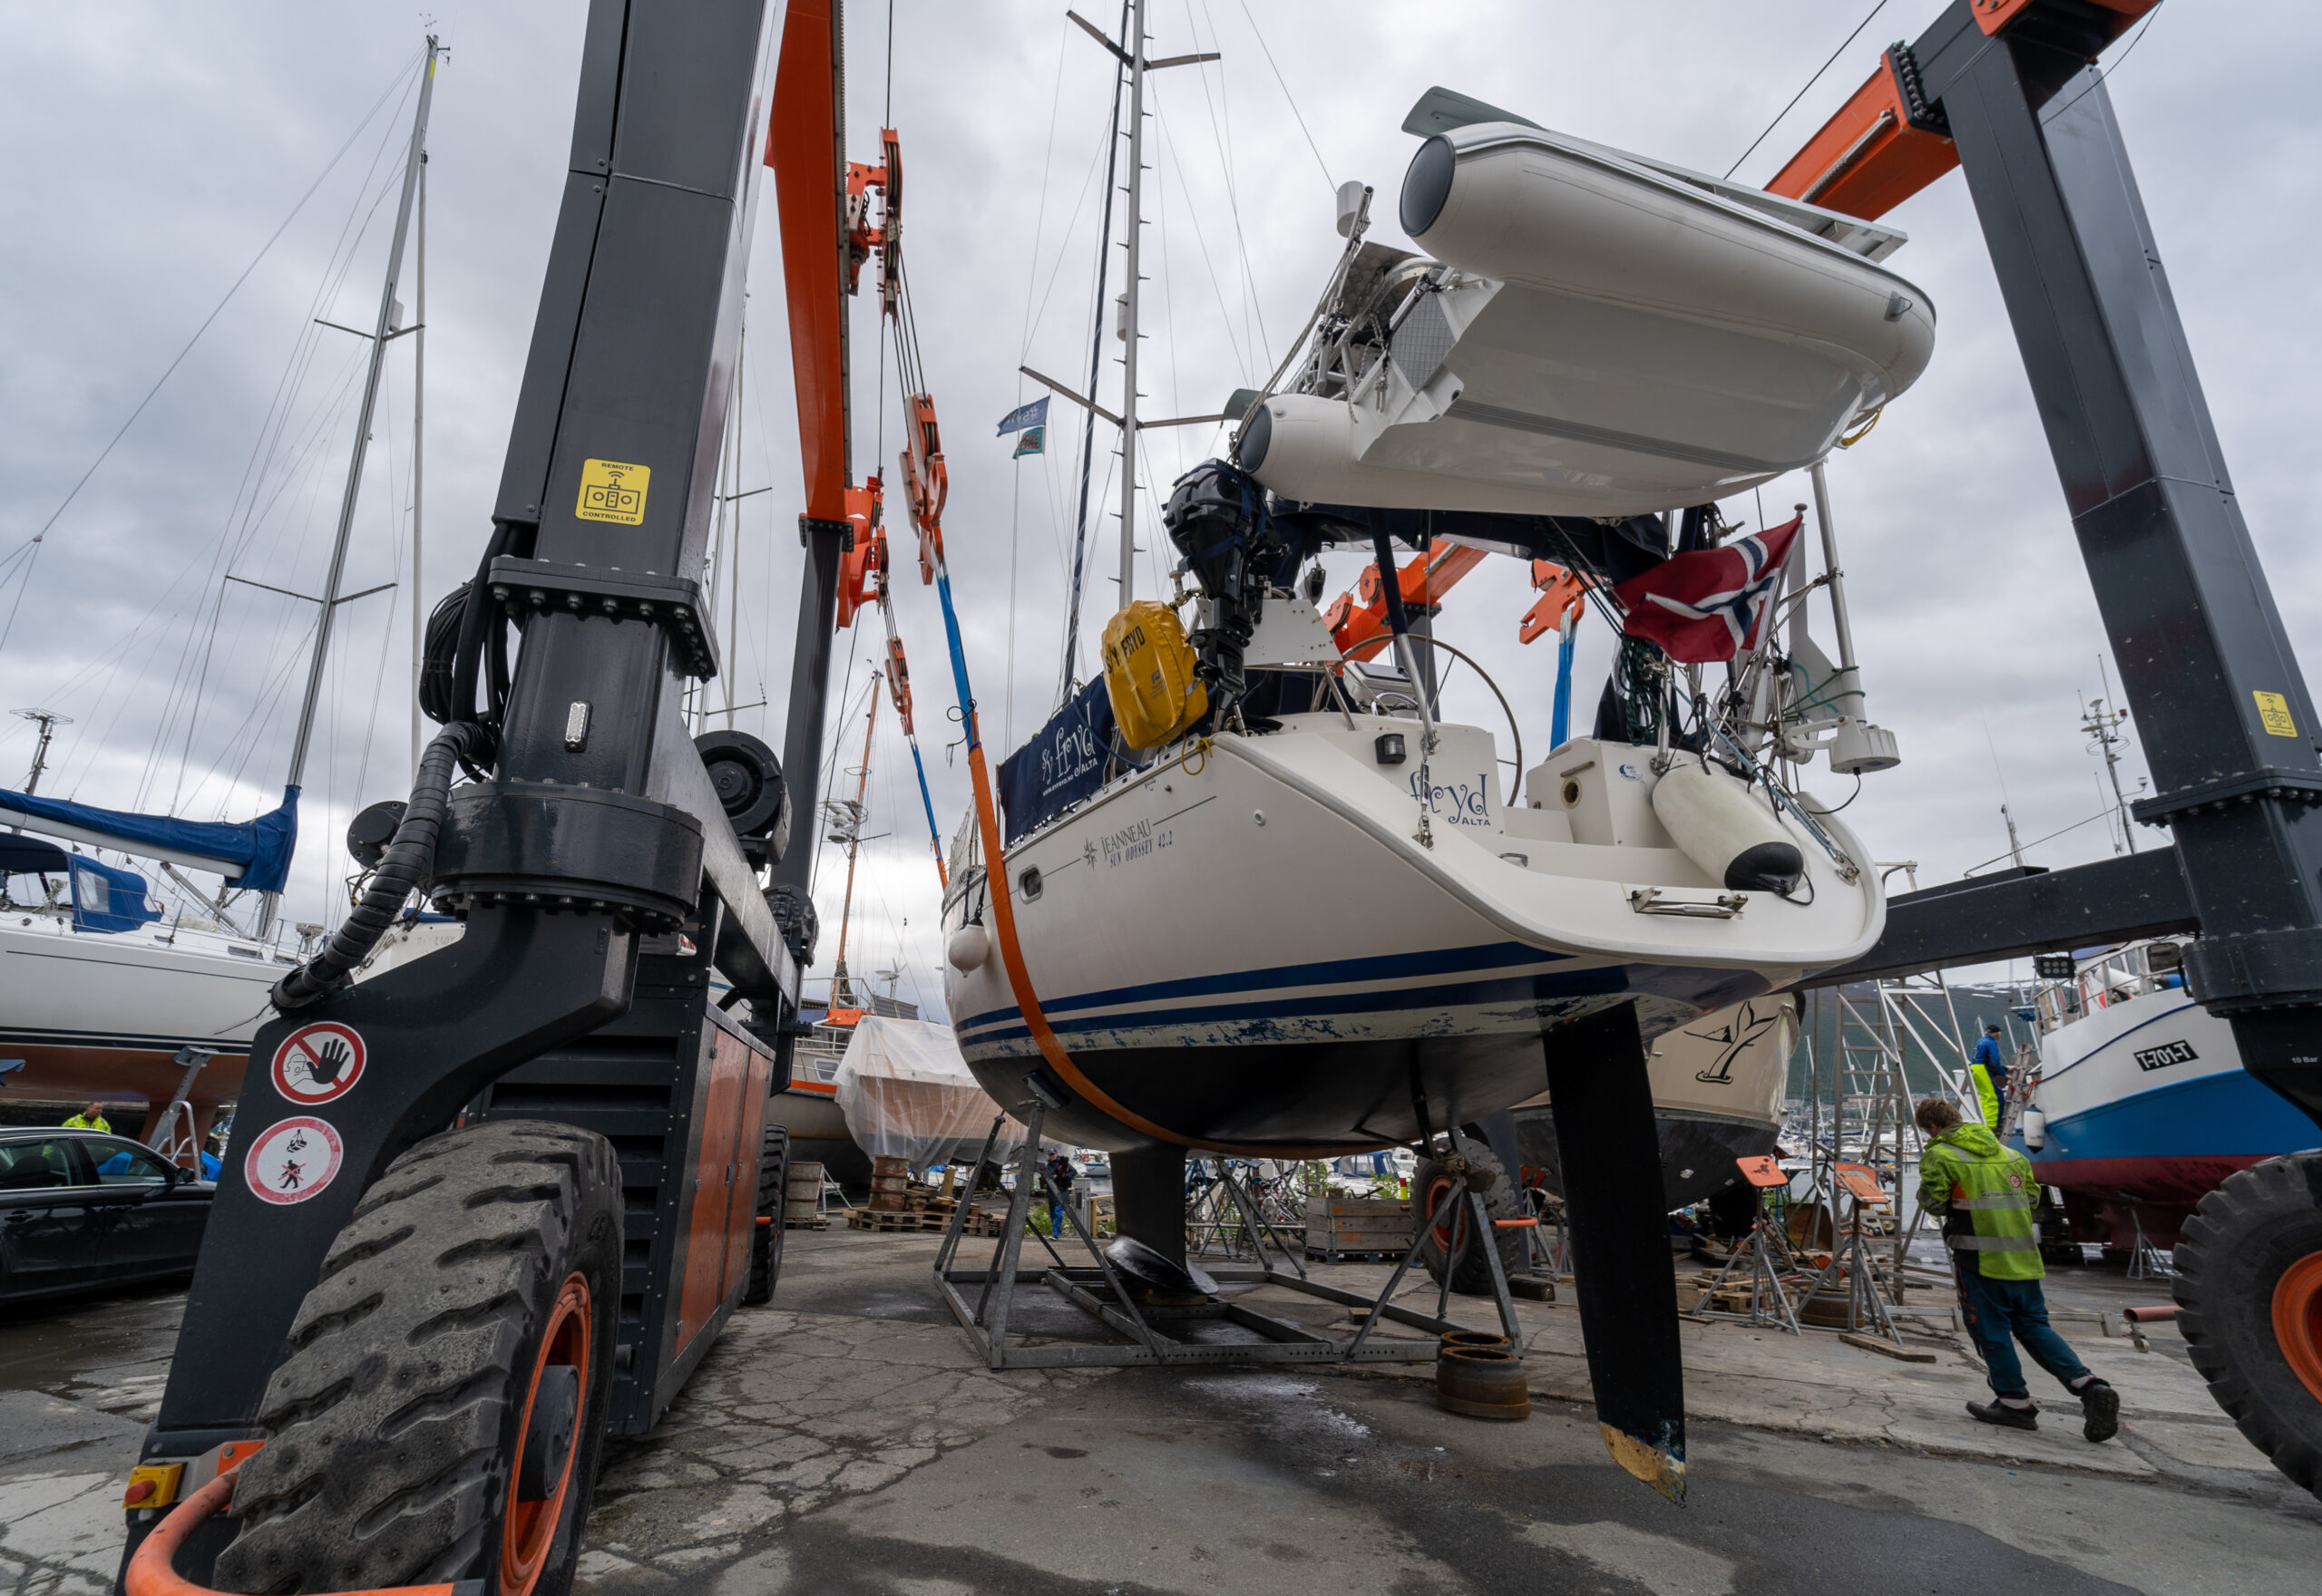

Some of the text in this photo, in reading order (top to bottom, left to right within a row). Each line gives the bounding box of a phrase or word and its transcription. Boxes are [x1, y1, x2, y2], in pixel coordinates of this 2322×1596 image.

[601, 462, 634, 472] REMOTE
[582, 511, 637, 522] CONTROLLED
[1105, 626, 1146, 677] S/Y FRYD
[1056, 700, 1096, 778] fryd
[1080, 757, 1098, 774] ALTA
[1410, 771, 1489, 824] fryd
[1461, 817, 1491, 826] ALTA
[1099, 818, 1152, 862] JEANNEAU
[1126, 838, 1153, 862] ODYSSEY
[2136, 1042, 2191, 1068] T-701-T
